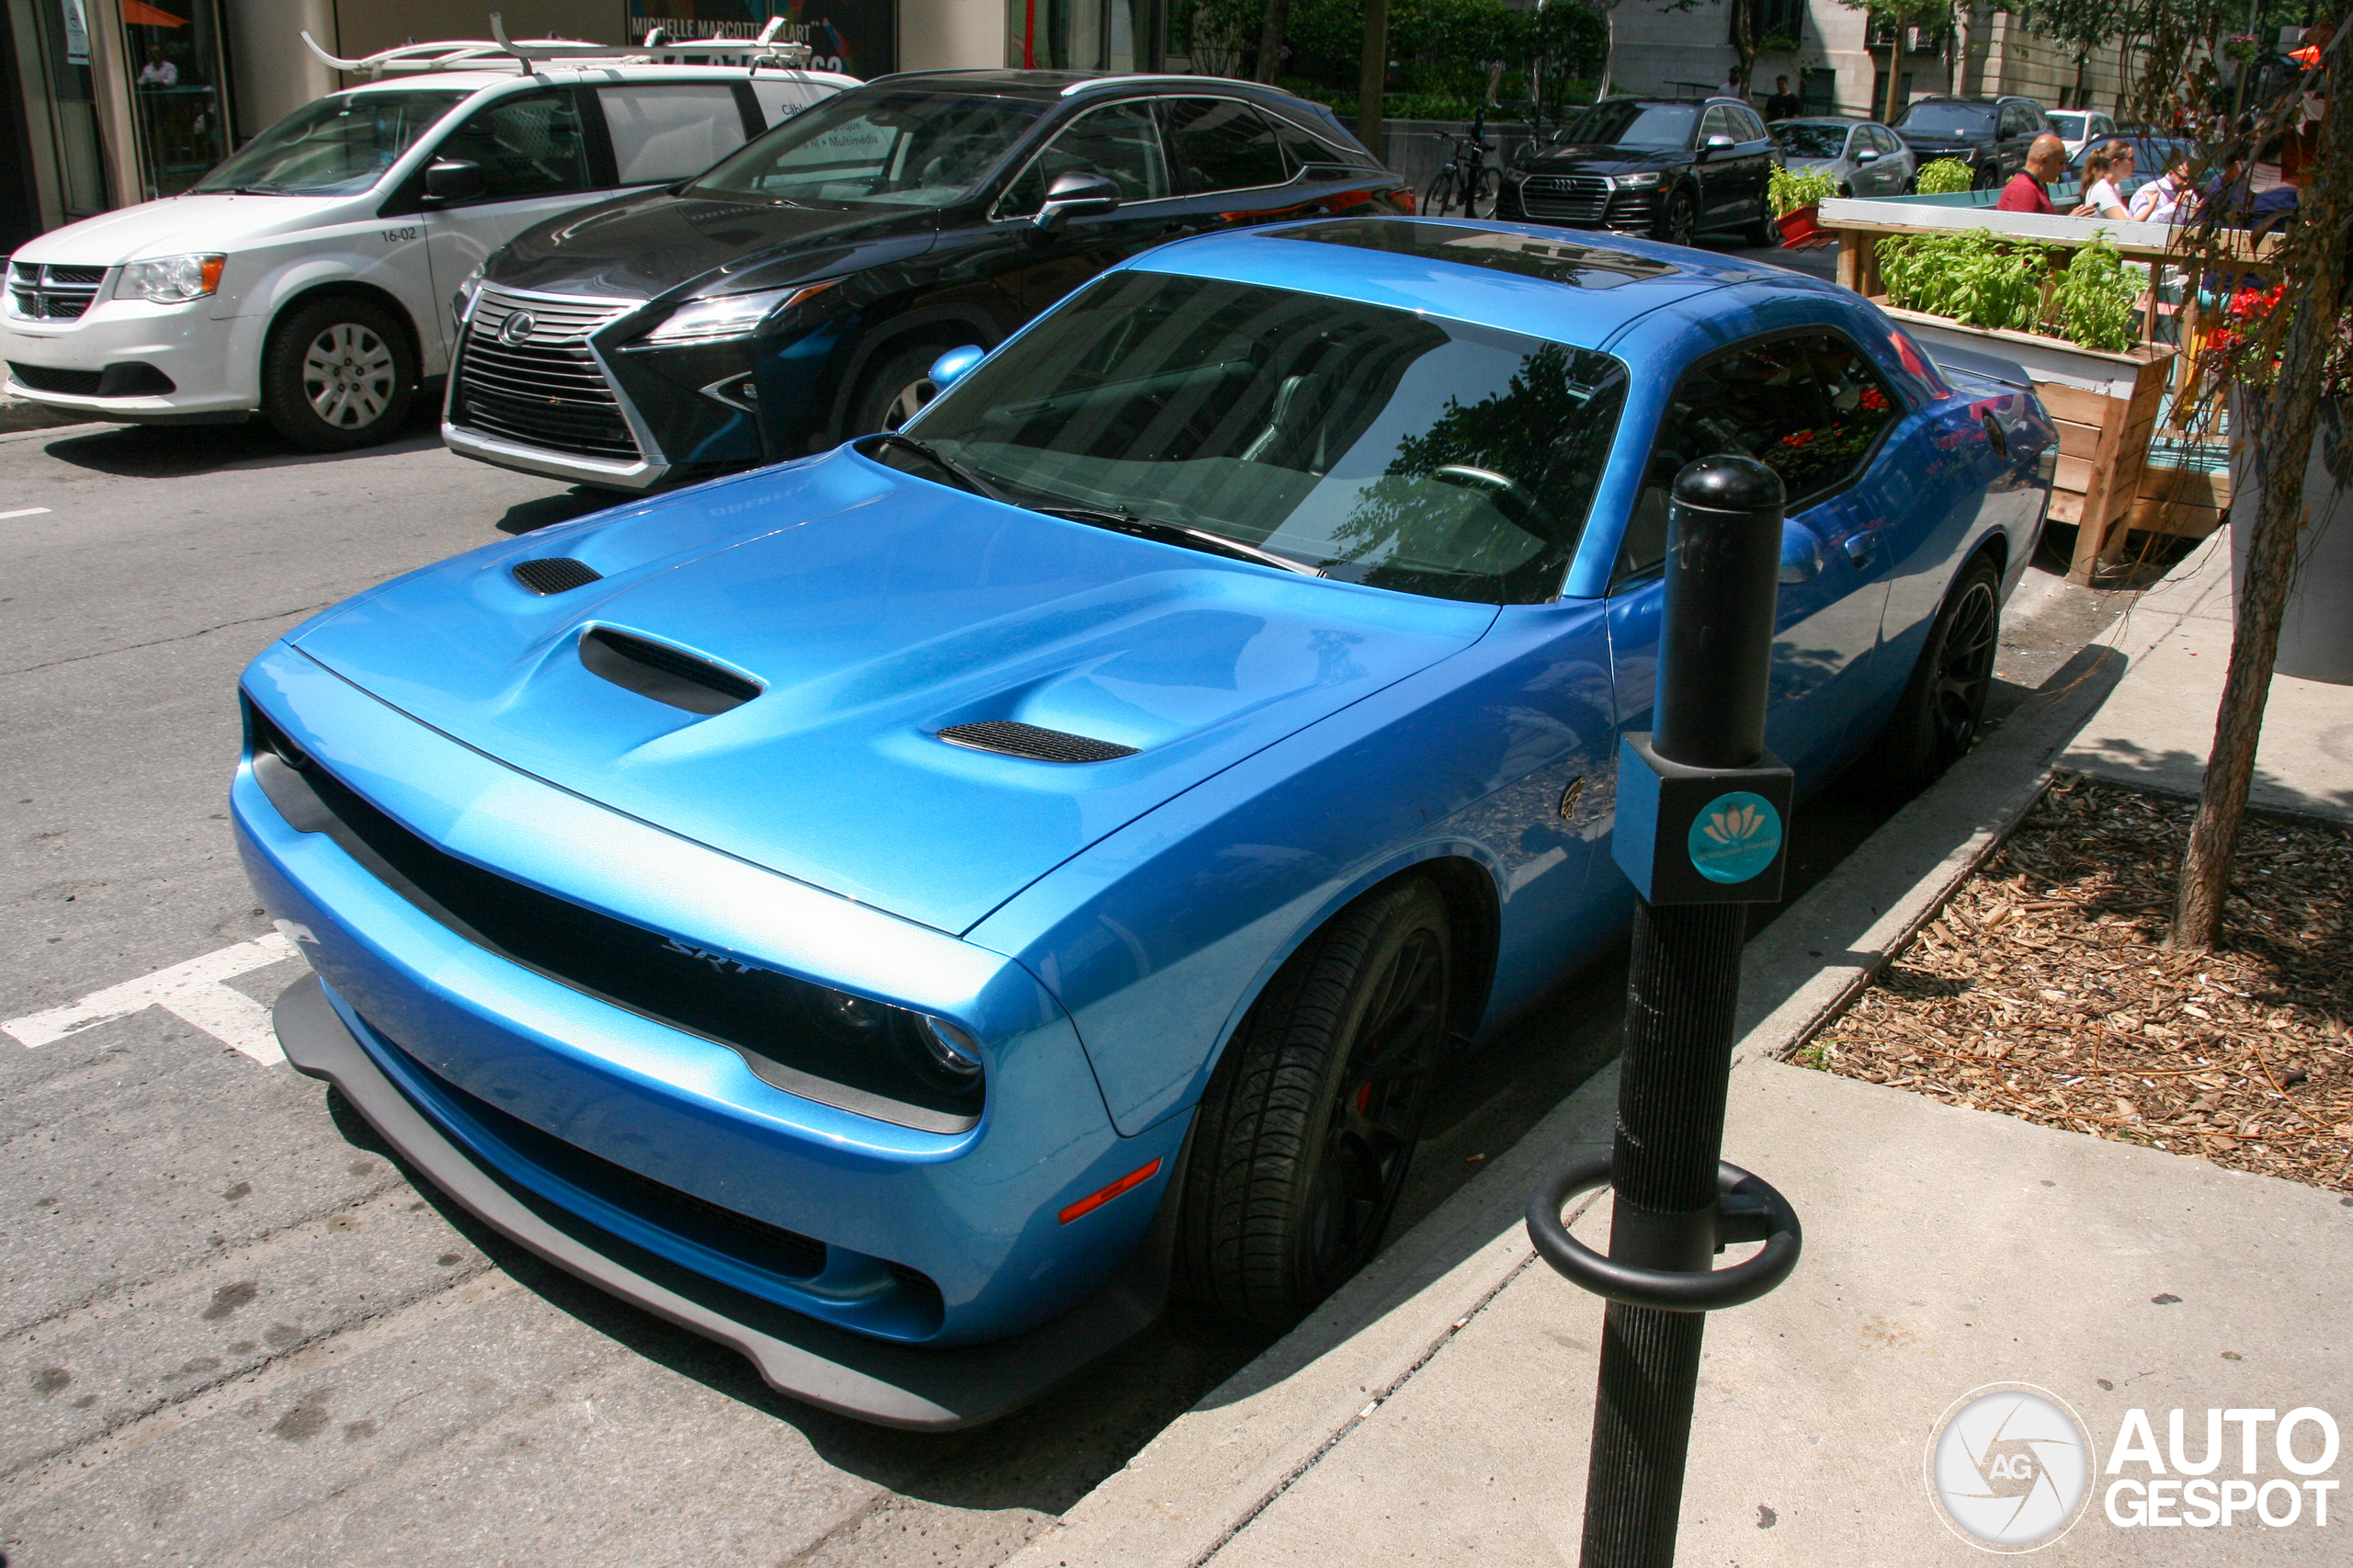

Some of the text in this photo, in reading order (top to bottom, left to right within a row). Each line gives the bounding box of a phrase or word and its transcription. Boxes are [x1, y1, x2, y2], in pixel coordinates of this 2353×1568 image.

[631, 17, 694, 38] MICHELLE
[828, 134, 879, 148] Multimédia
[381, 227, 417, 243] 16-02
[661, 937, 763, 974] SRT
